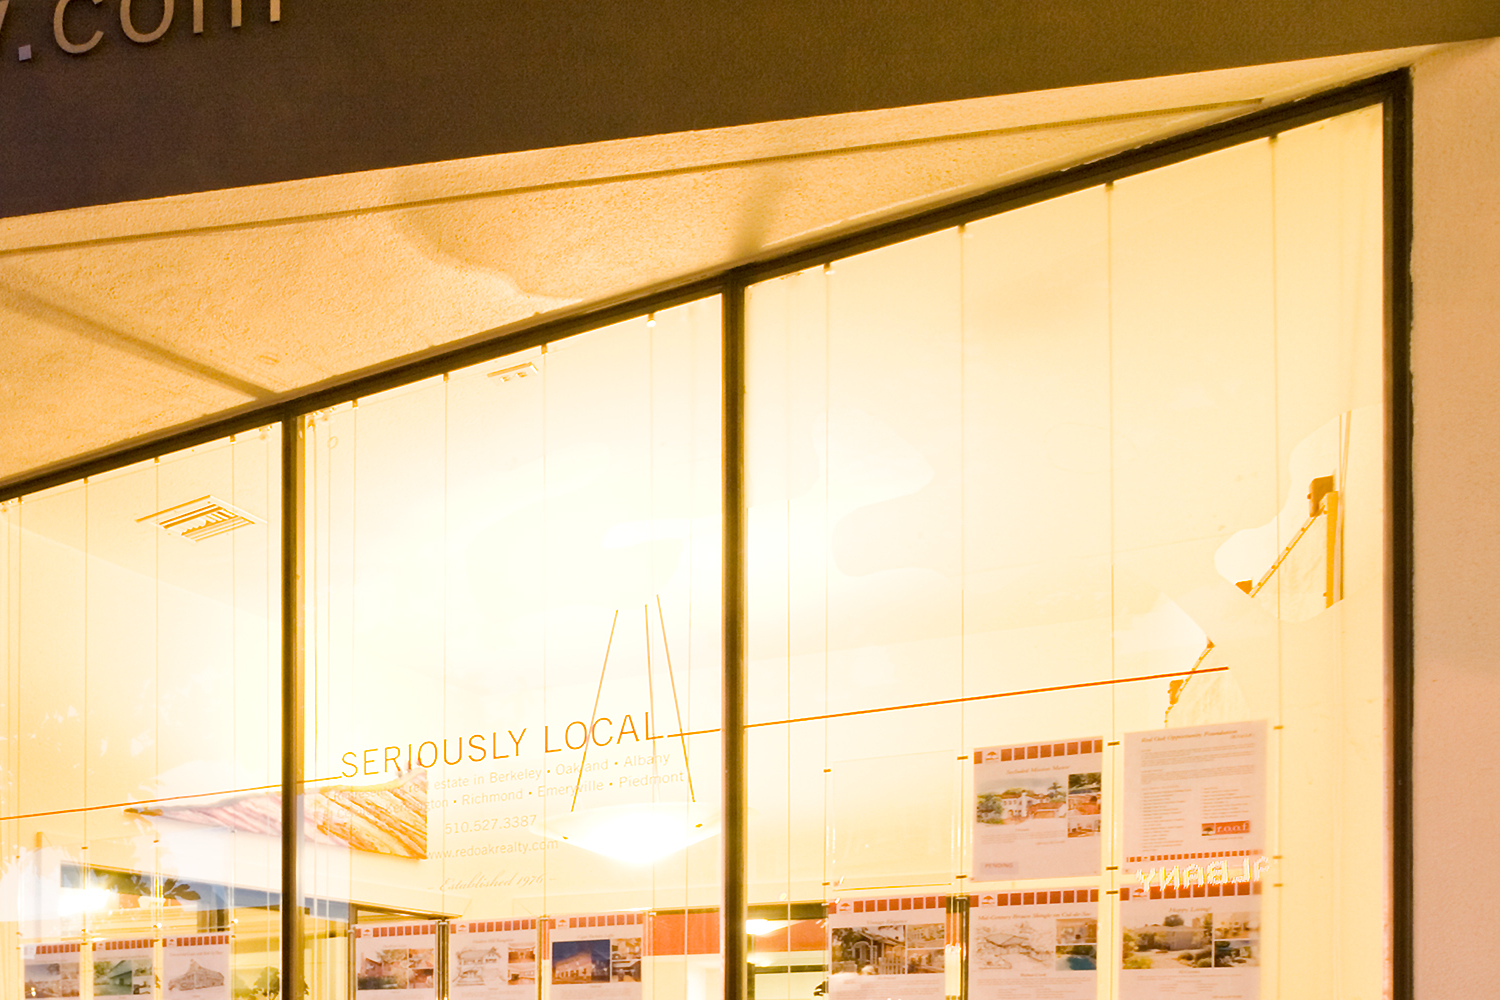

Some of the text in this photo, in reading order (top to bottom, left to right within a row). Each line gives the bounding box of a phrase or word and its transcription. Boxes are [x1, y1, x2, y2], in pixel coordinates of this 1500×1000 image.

[341, 711, 664, 778] SERIOUSLY LOCAL
[434, 777, 469, 790] estate
[473, 773, 485, 785] in
[489, 768, 542, 784] Berkeley
[555, 759, 609, 776] Oakand
[623, 754, 670, 768] Albany
[462, 788, 523, 806] Richmond
[537, 781, 604, 797] Emeryville
[619, 772, 684, 788] Piedmont
[444, 814, 537, 835] 510.527.3387
[426, 840, 559, 860] www.redoakrealty.com
